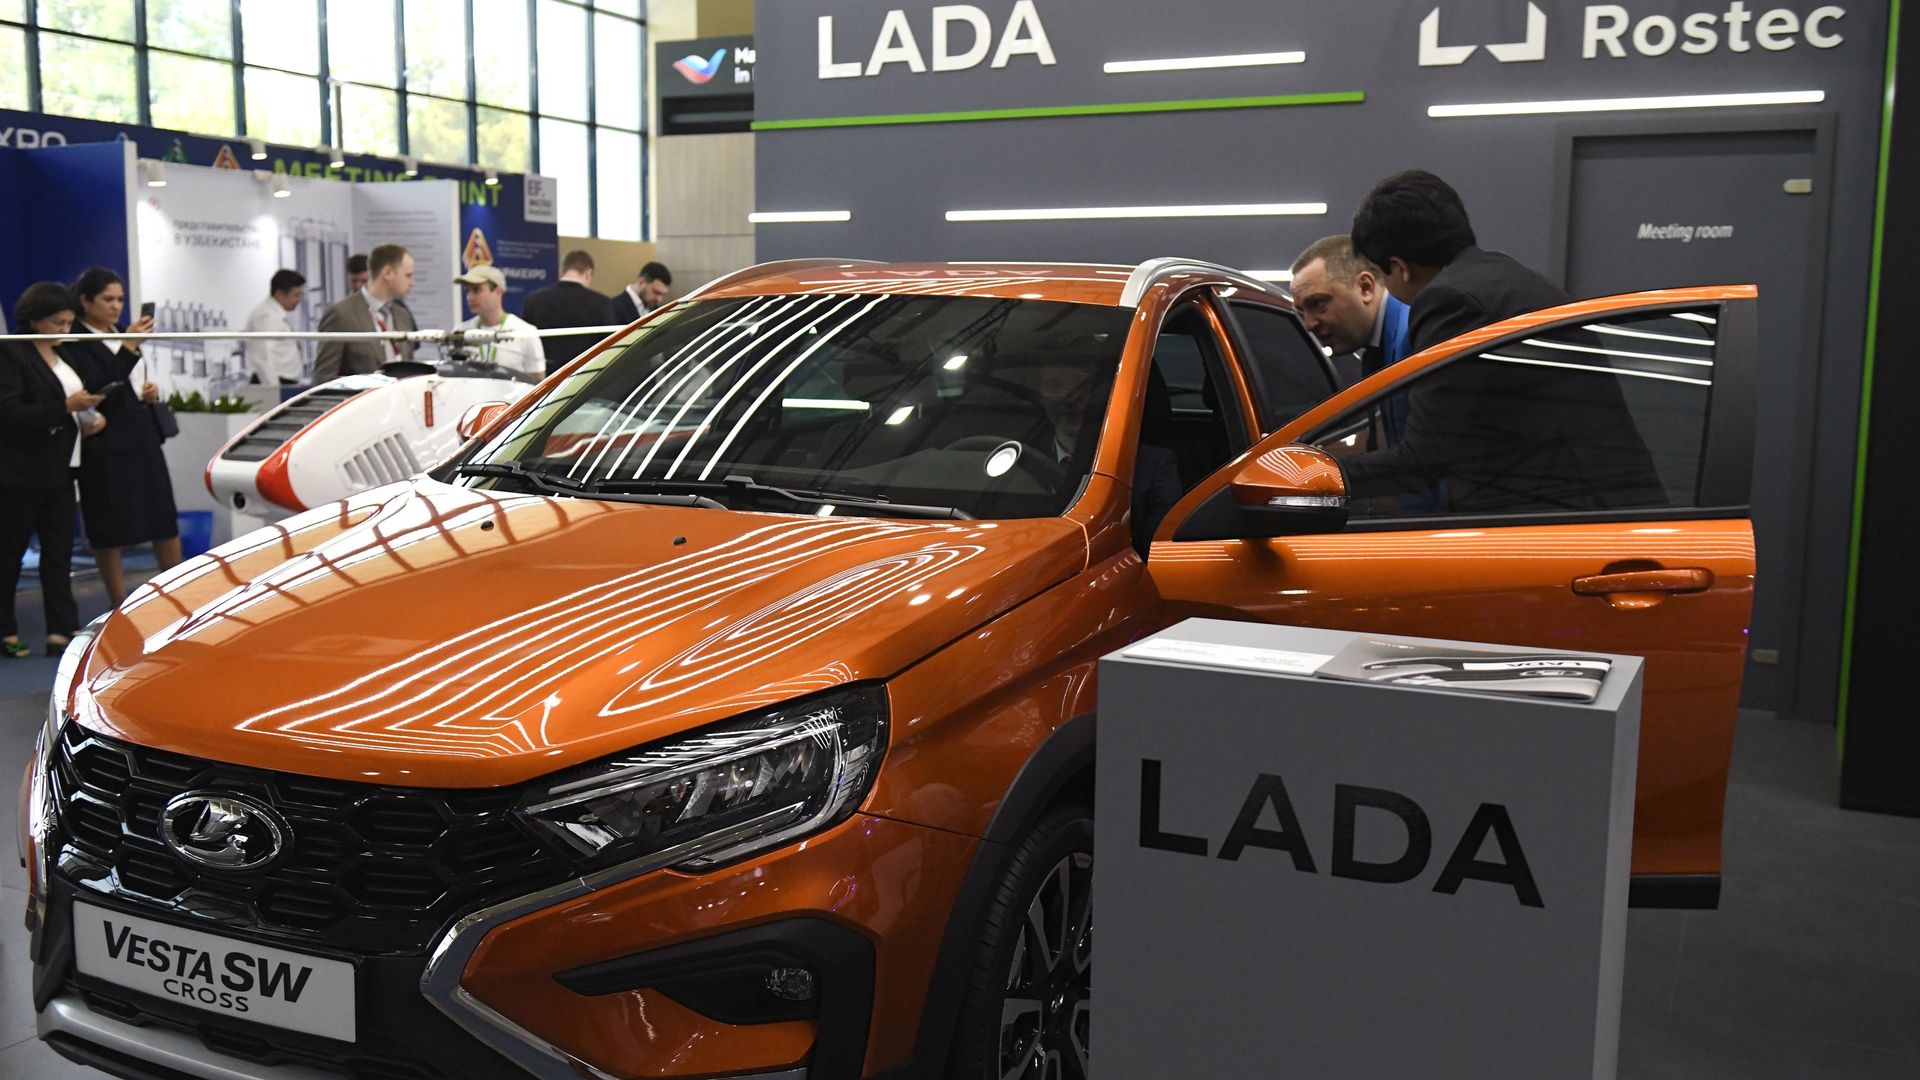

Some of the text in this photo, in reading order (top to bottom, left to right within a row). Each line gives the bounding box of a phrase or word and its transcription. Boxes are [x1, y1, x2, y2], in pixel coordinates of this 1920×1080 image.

[818, 0, 1057, 79] LADA
[1582, 1, 1846, 59] Rostec
[735, 67, 750, 84] in
[1637, 223, 1734, 243] Meeting room
[1139, 758, 1545, 909] LADA
[103, 920, 313, 1003] VESTA SW
[163, 978, 249, 1013] CROSS
